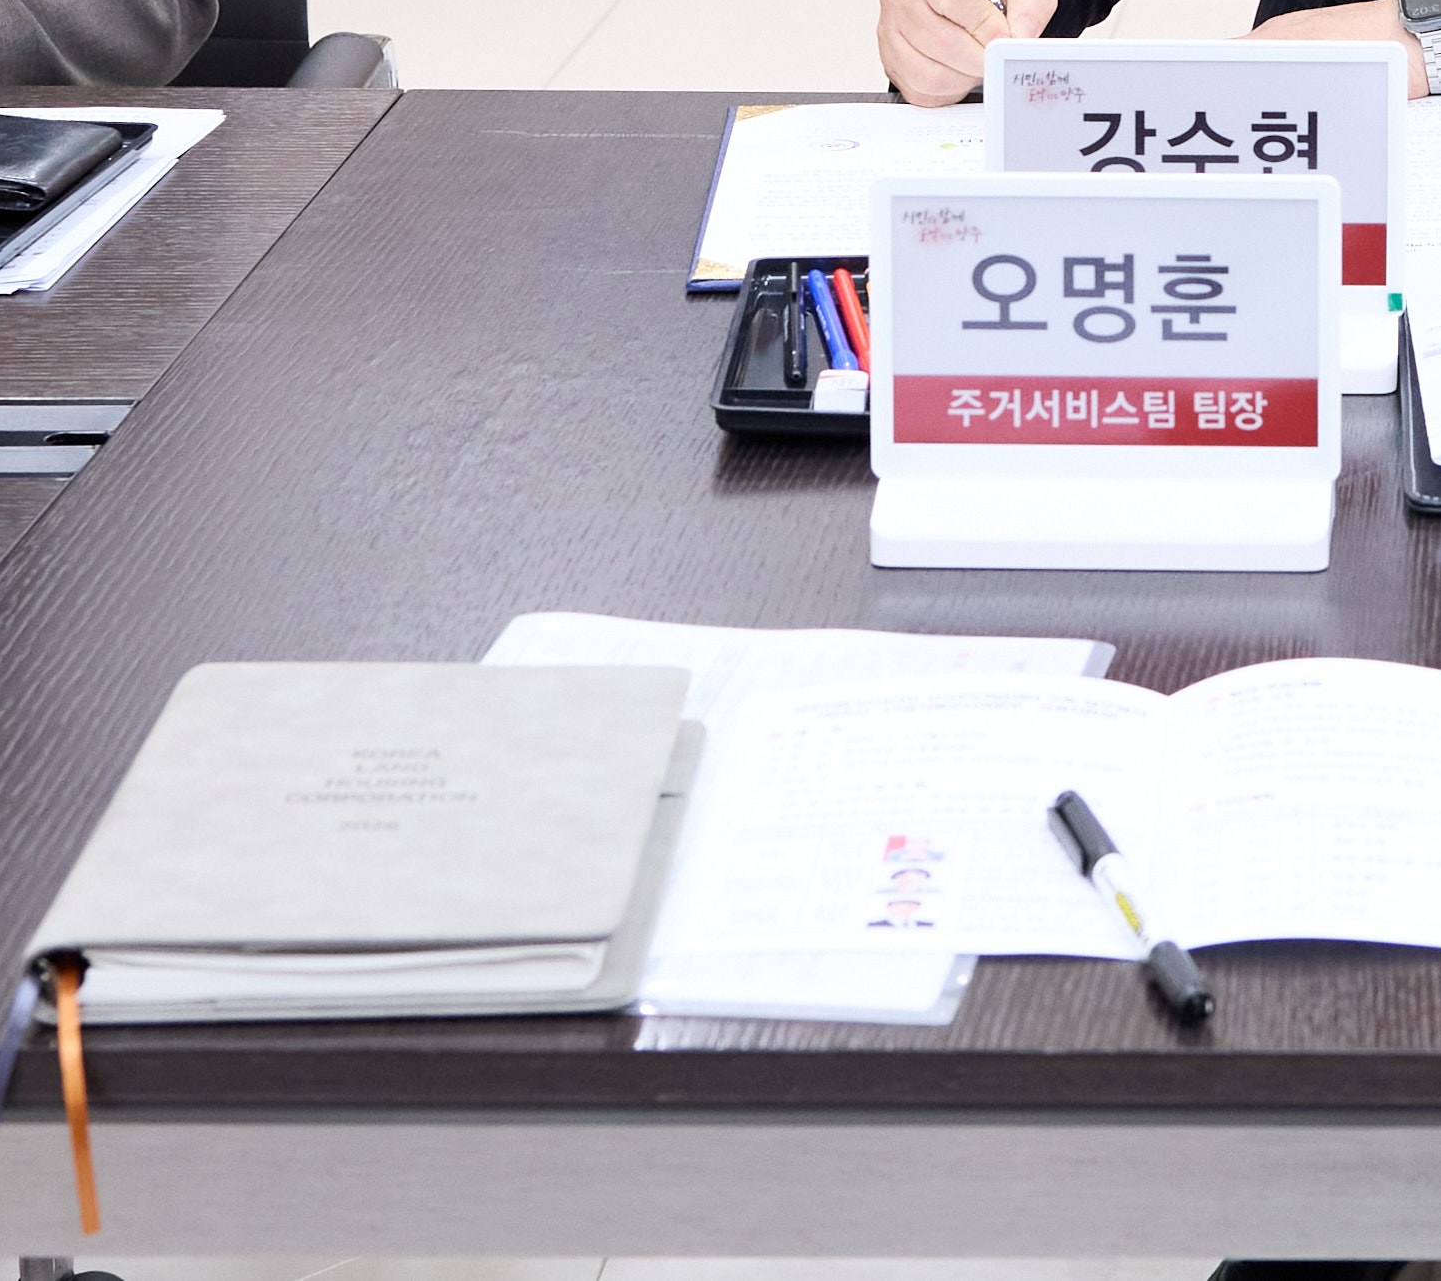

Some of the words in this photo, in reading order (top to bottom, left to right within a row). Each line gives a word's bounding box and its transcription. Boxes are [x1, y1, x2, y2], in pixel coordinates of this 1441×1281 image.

[1412, 4, 1440, 16] 3:02
[962, 254, 1236, 343] 오명훈
[947, 388, 1177, 430] 주거서비스팀
[1193, 390, 1268, 431] 팀장
